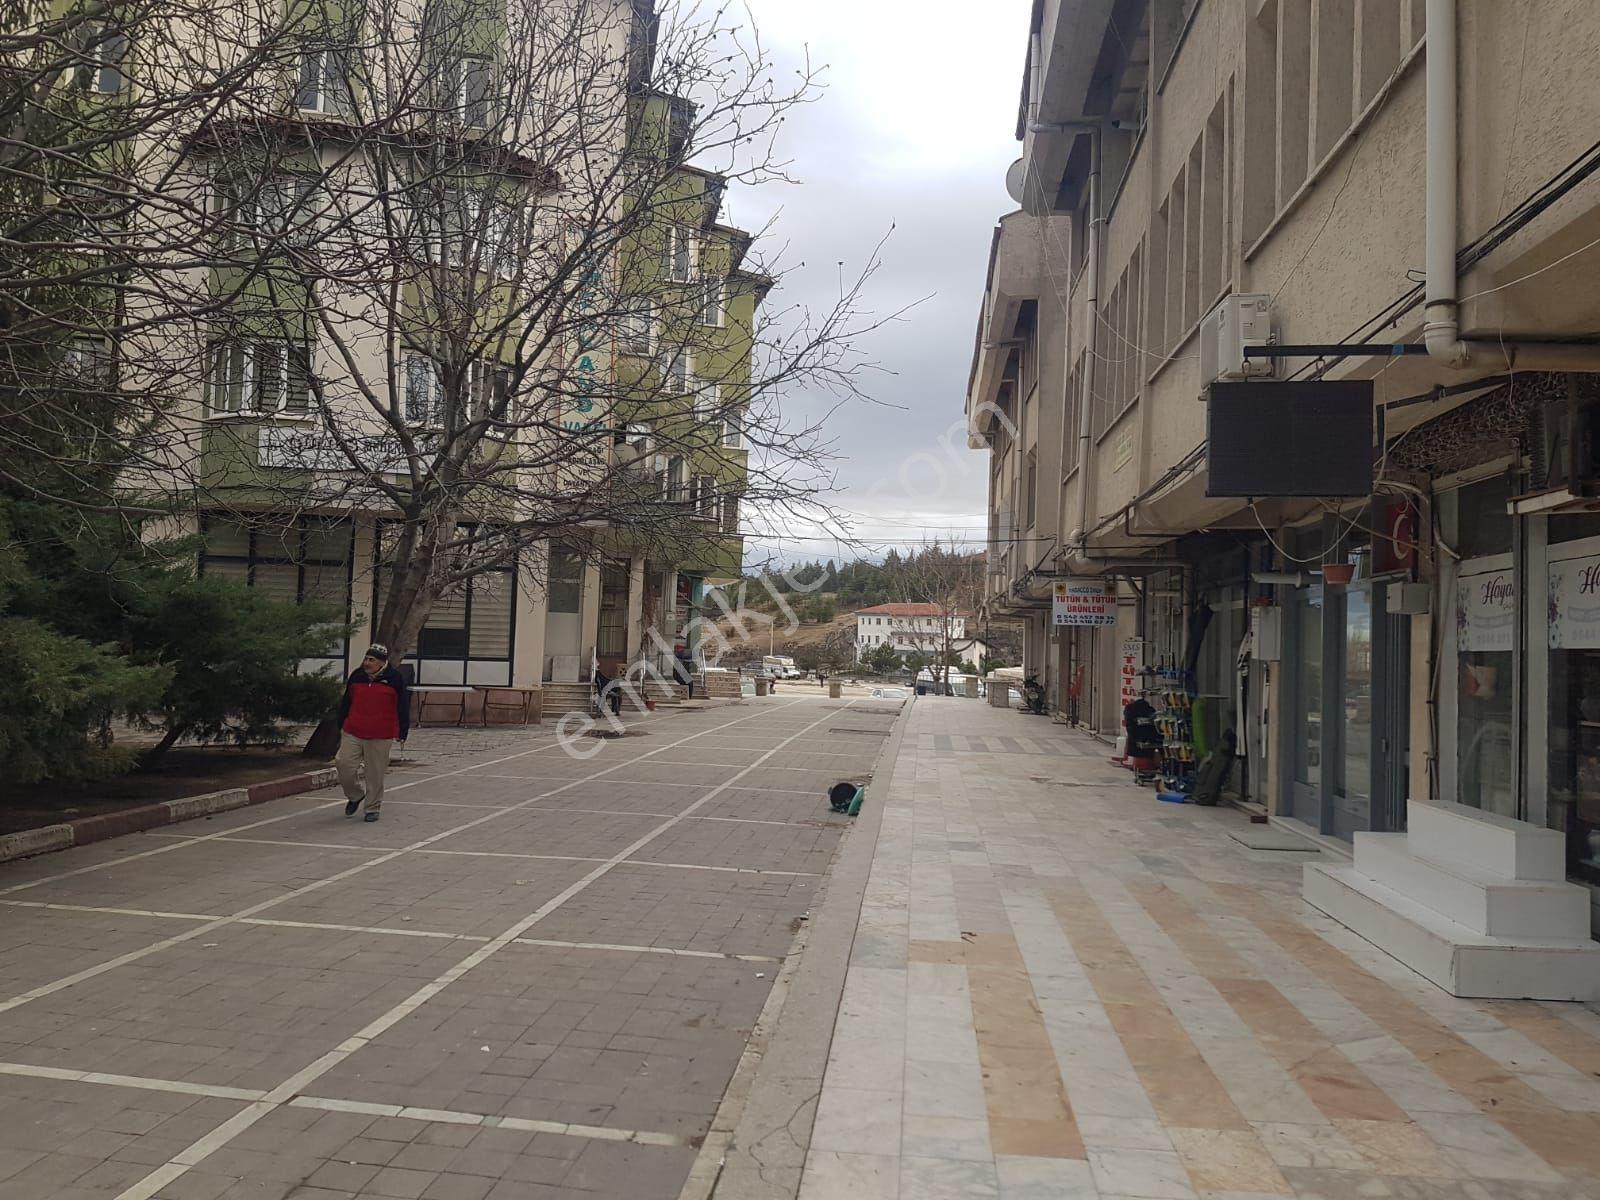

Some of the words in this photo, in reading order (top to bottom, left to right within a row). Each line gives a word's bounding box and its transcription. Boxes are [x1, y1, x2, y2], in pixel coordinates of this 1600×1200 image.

[1056, 595, 1081, 604] TÜTÜN
[1091, 594, 1116, 604] TÜTÜN
[1067, 604, 1105, 613] ÜRÜNLERİ
